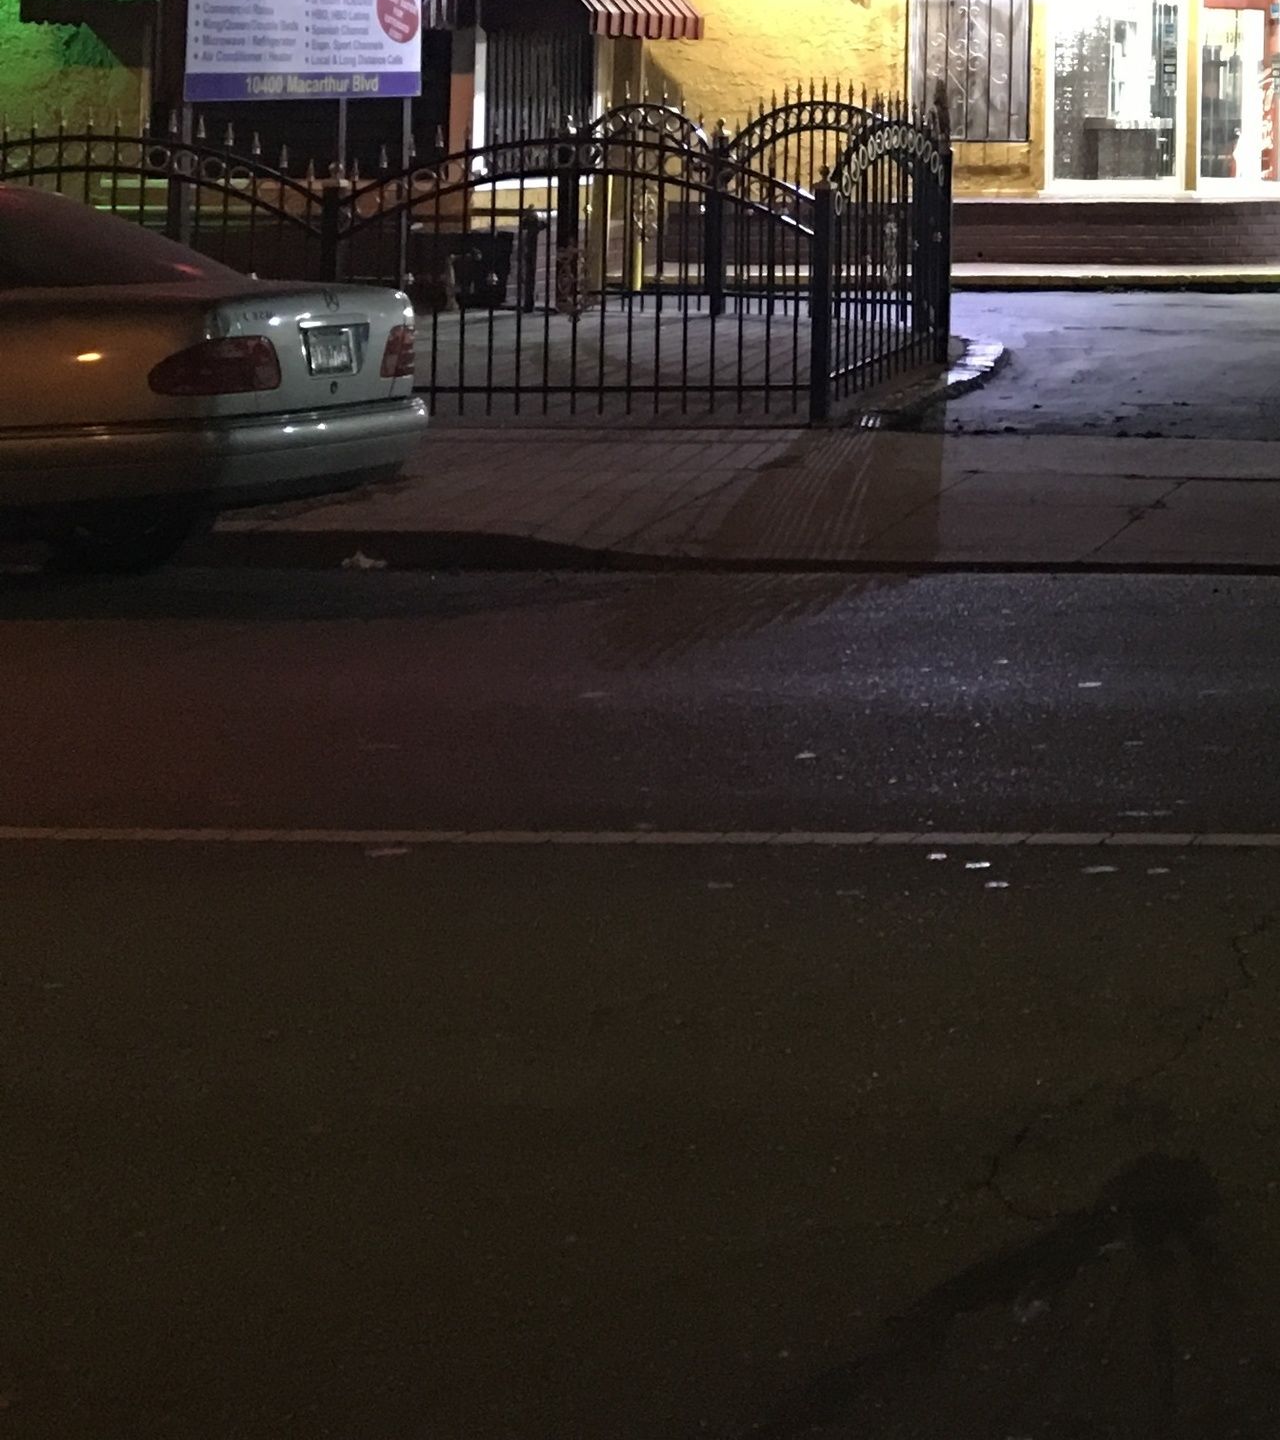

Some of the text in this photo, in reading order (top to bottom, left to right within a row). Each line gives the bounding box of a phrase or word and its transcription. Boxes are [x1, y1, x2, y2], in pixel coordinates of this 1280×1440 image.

[246, 75, 380, 95] 10400 Macarthur Blvd
